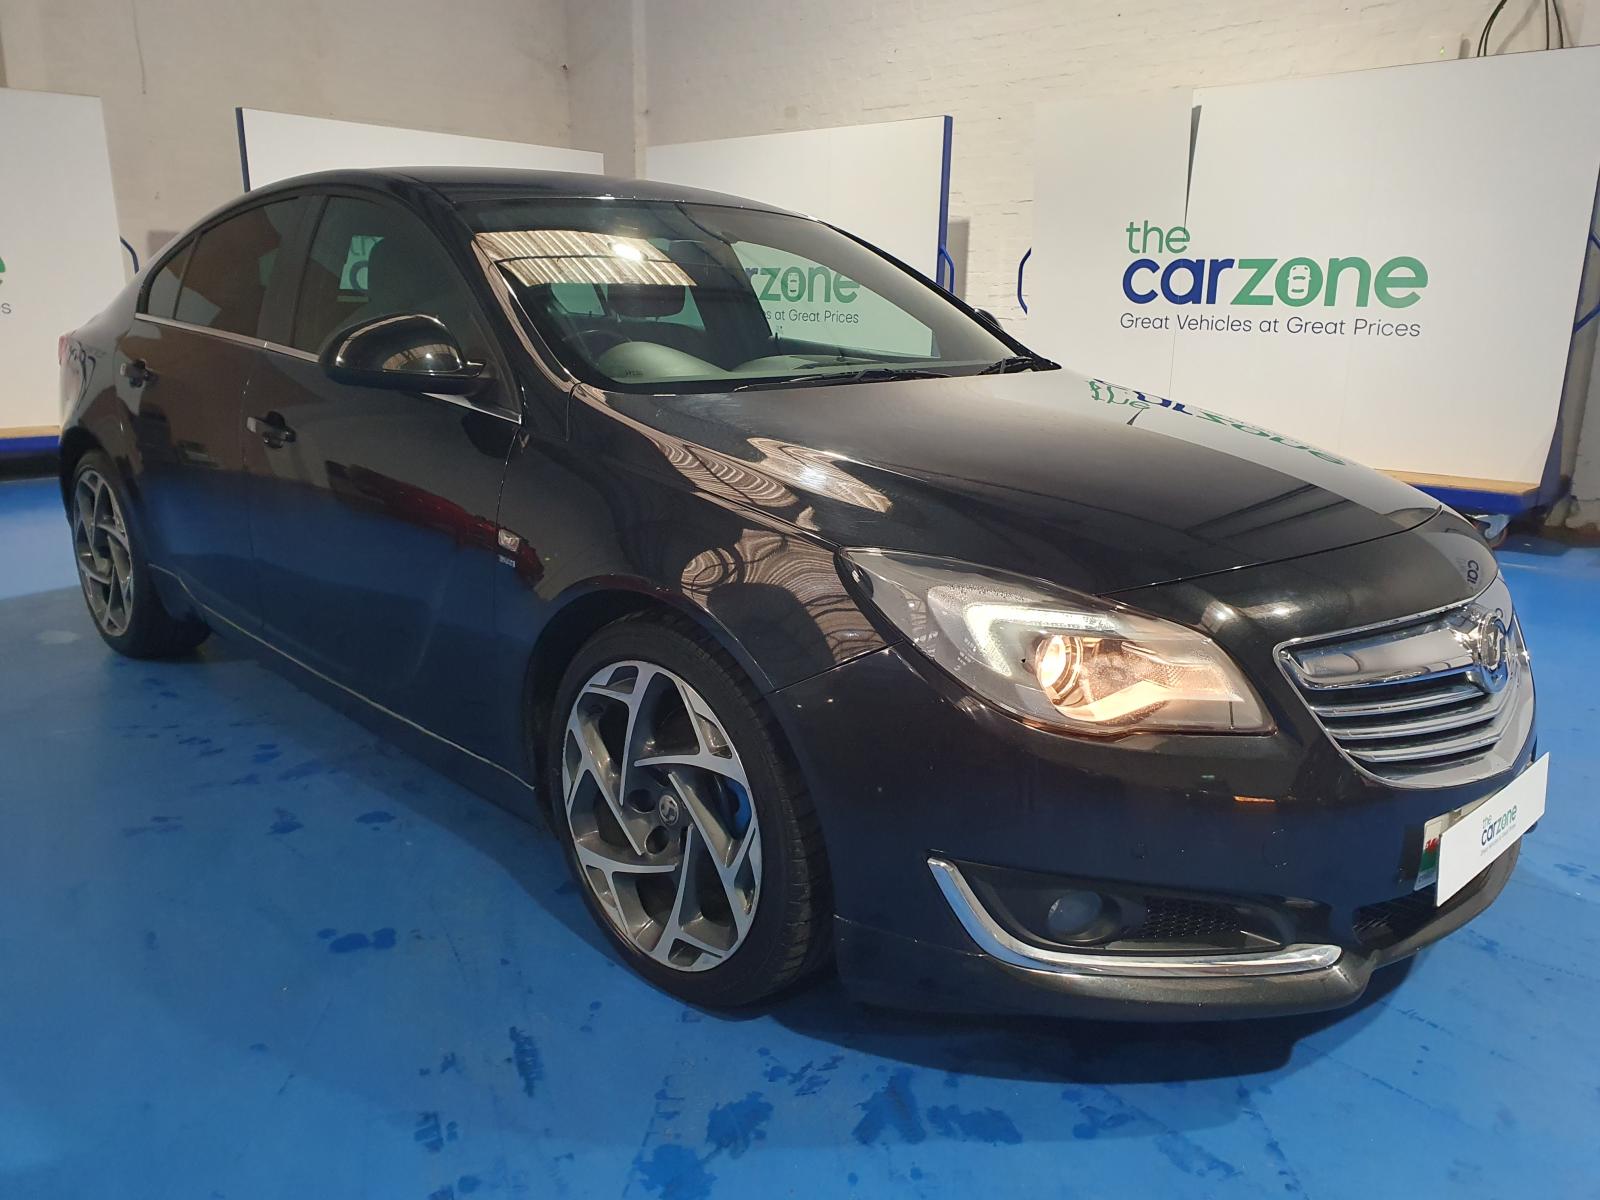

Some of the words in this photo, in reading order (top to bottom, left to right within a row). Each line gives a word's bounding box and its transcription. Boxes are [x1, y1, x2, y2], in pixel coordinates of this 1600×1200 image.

[1126, 220, 1191, 254] the
[1122, 256, 1429, 309] carzone
[775, 311, 785, 321] at
[788, 309, 820, 322] Great
[824, 310, 859, 324] Prices
[1120, 312, 1170, 329] Great
[1177, 314, 1252, 332] Vehicles
[1259, 318, 1279, 333] at
[1286, 316, 1346, 335] Great
[1353, 318, 1421, 337] Prices
[1481, 805, 1517, 845] carzone
